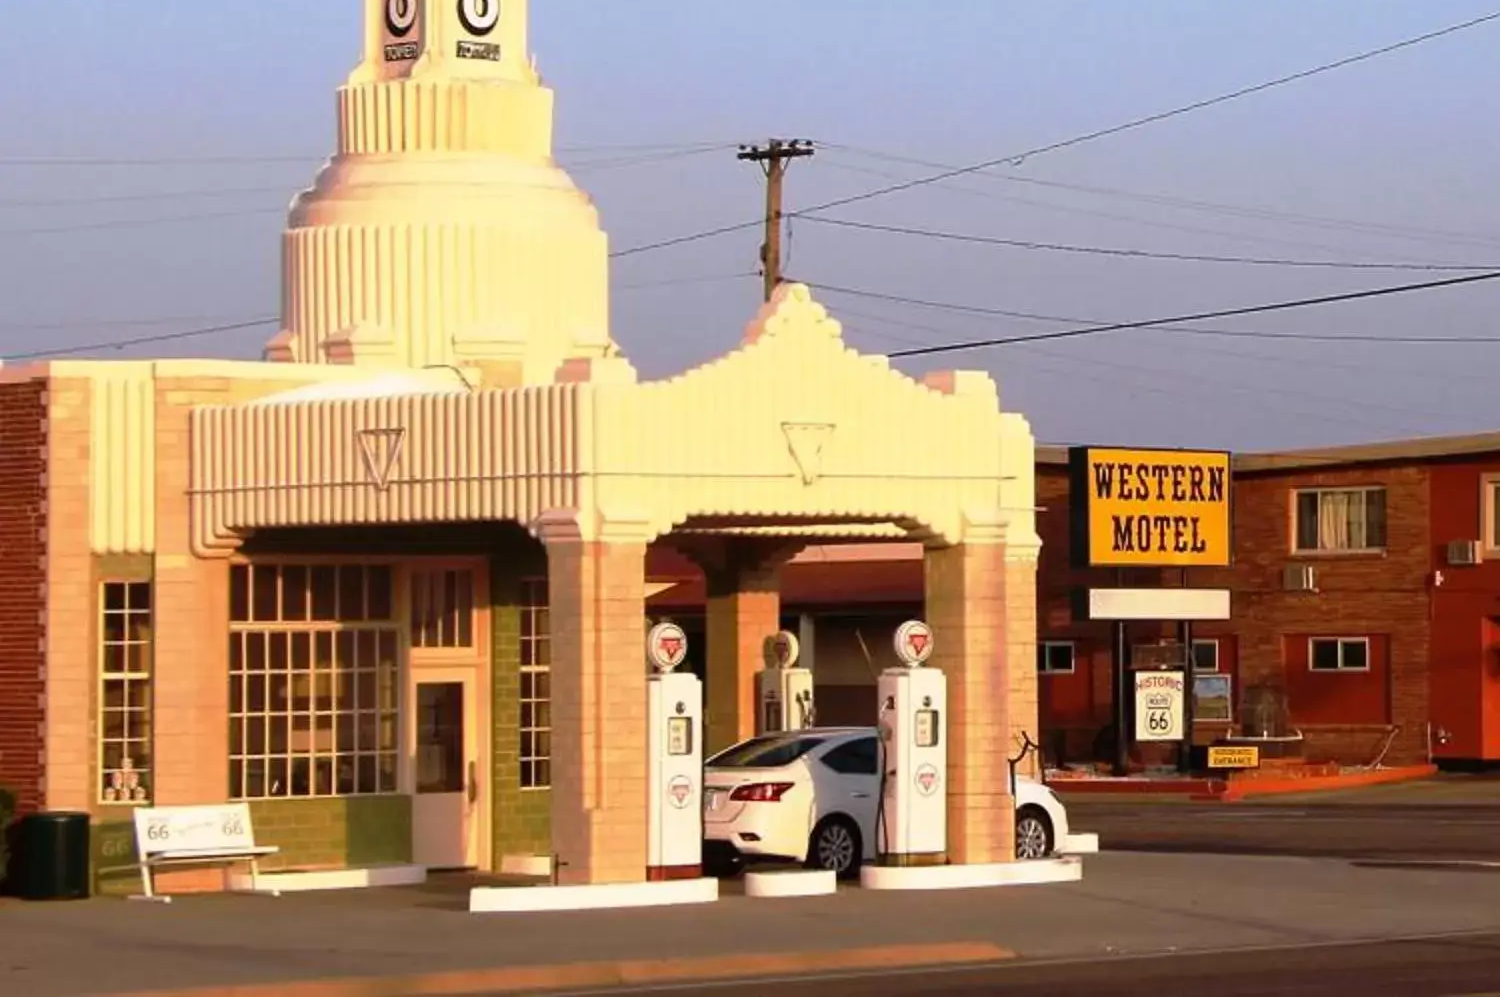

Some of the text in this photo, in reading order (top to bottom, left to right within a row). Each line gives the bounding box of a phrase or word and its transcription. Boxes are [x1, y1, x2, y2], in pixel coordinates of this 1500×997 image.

[1093, 462, 1225, 502] WESTERN
[1111, 515, 1207, 553] MOTEL
[1135, 676, 1184, 692] HISTORIC
[1148, 710, 1169, 731] 66
[147, 824, 170, 840] 66
